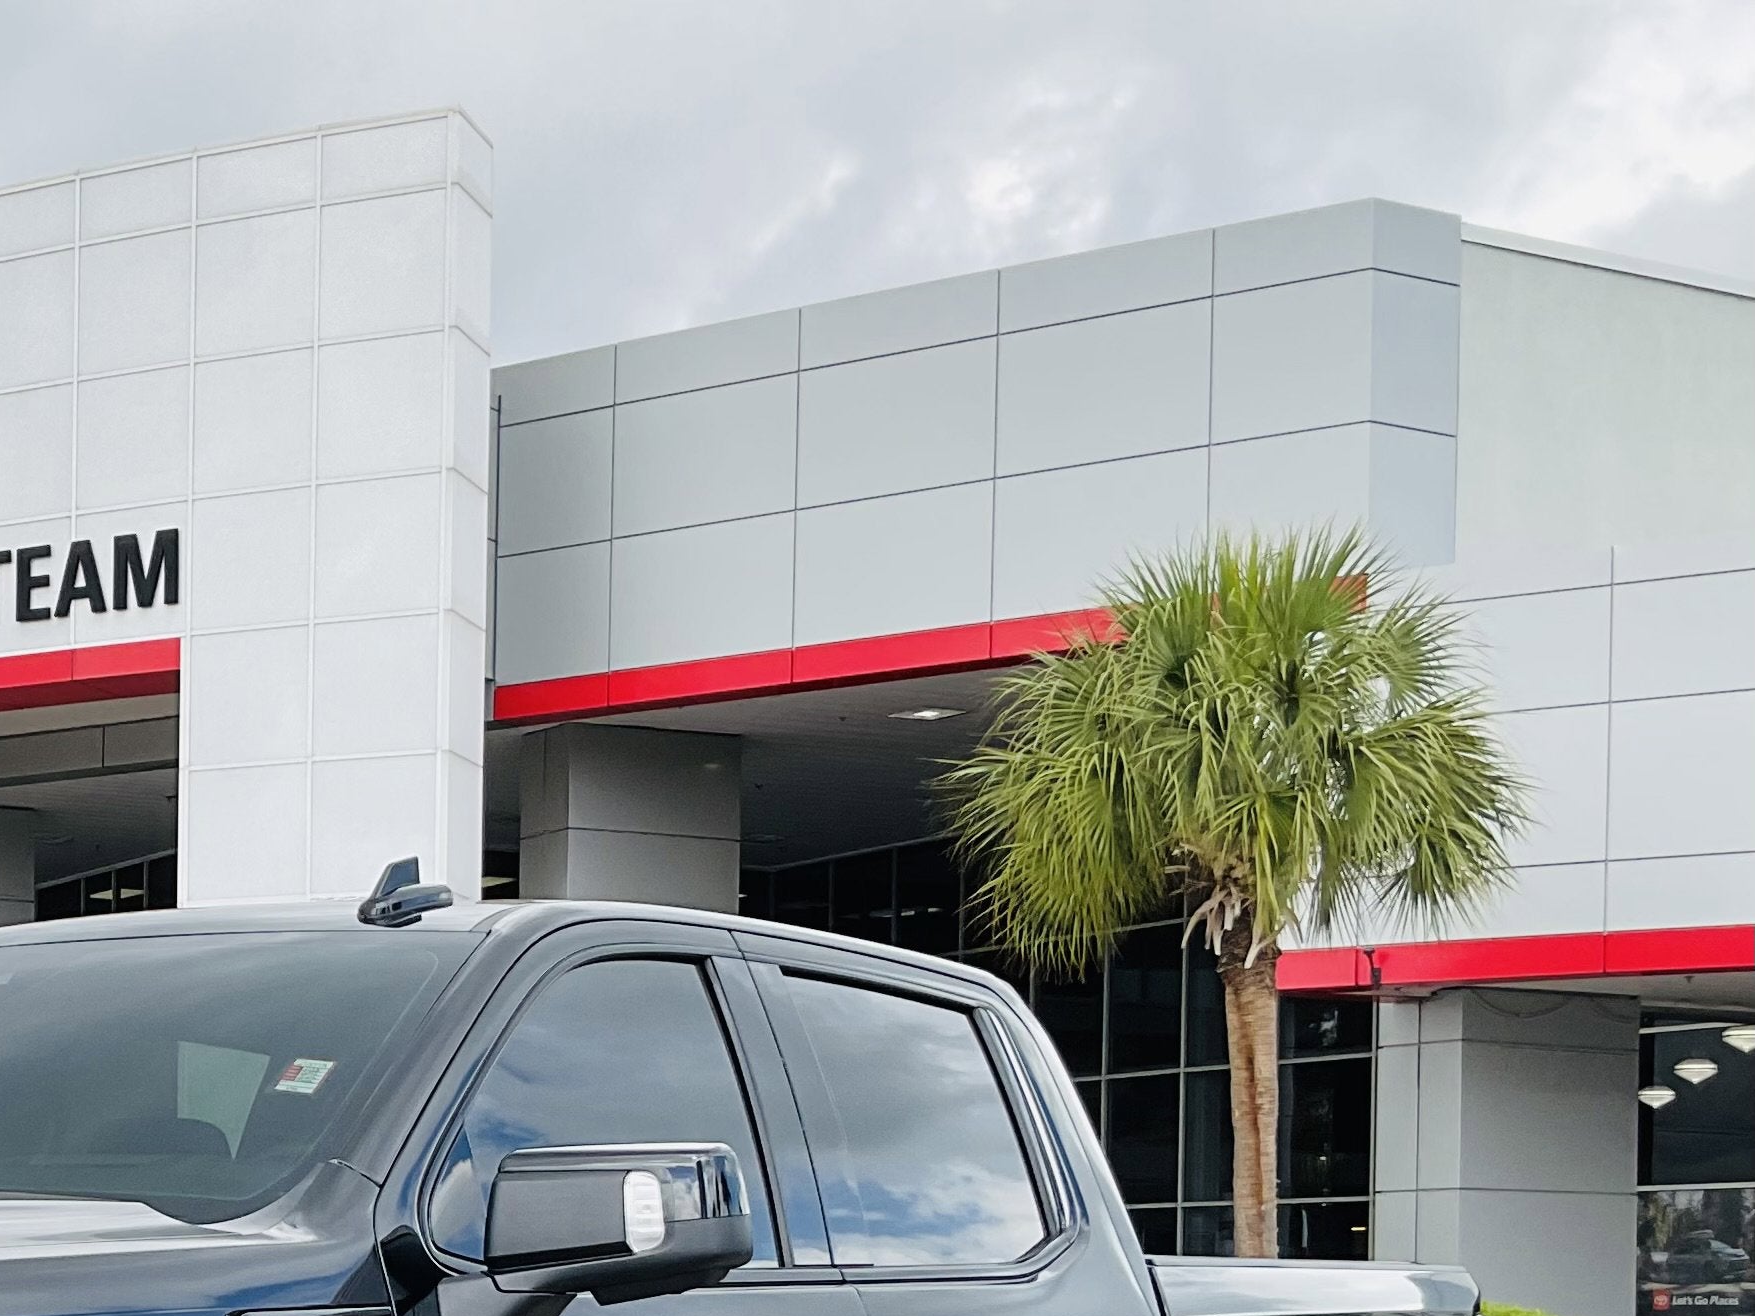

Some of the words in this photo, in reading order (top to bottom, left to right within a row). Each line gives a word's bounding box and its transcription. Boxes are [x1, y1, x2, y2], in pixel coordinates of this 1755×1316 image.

[1672, 1295, 1693, 1305] Let's
[1695, 1295, 1708, 1305] Go
[1709, 1295, 1739, 1305] Places
